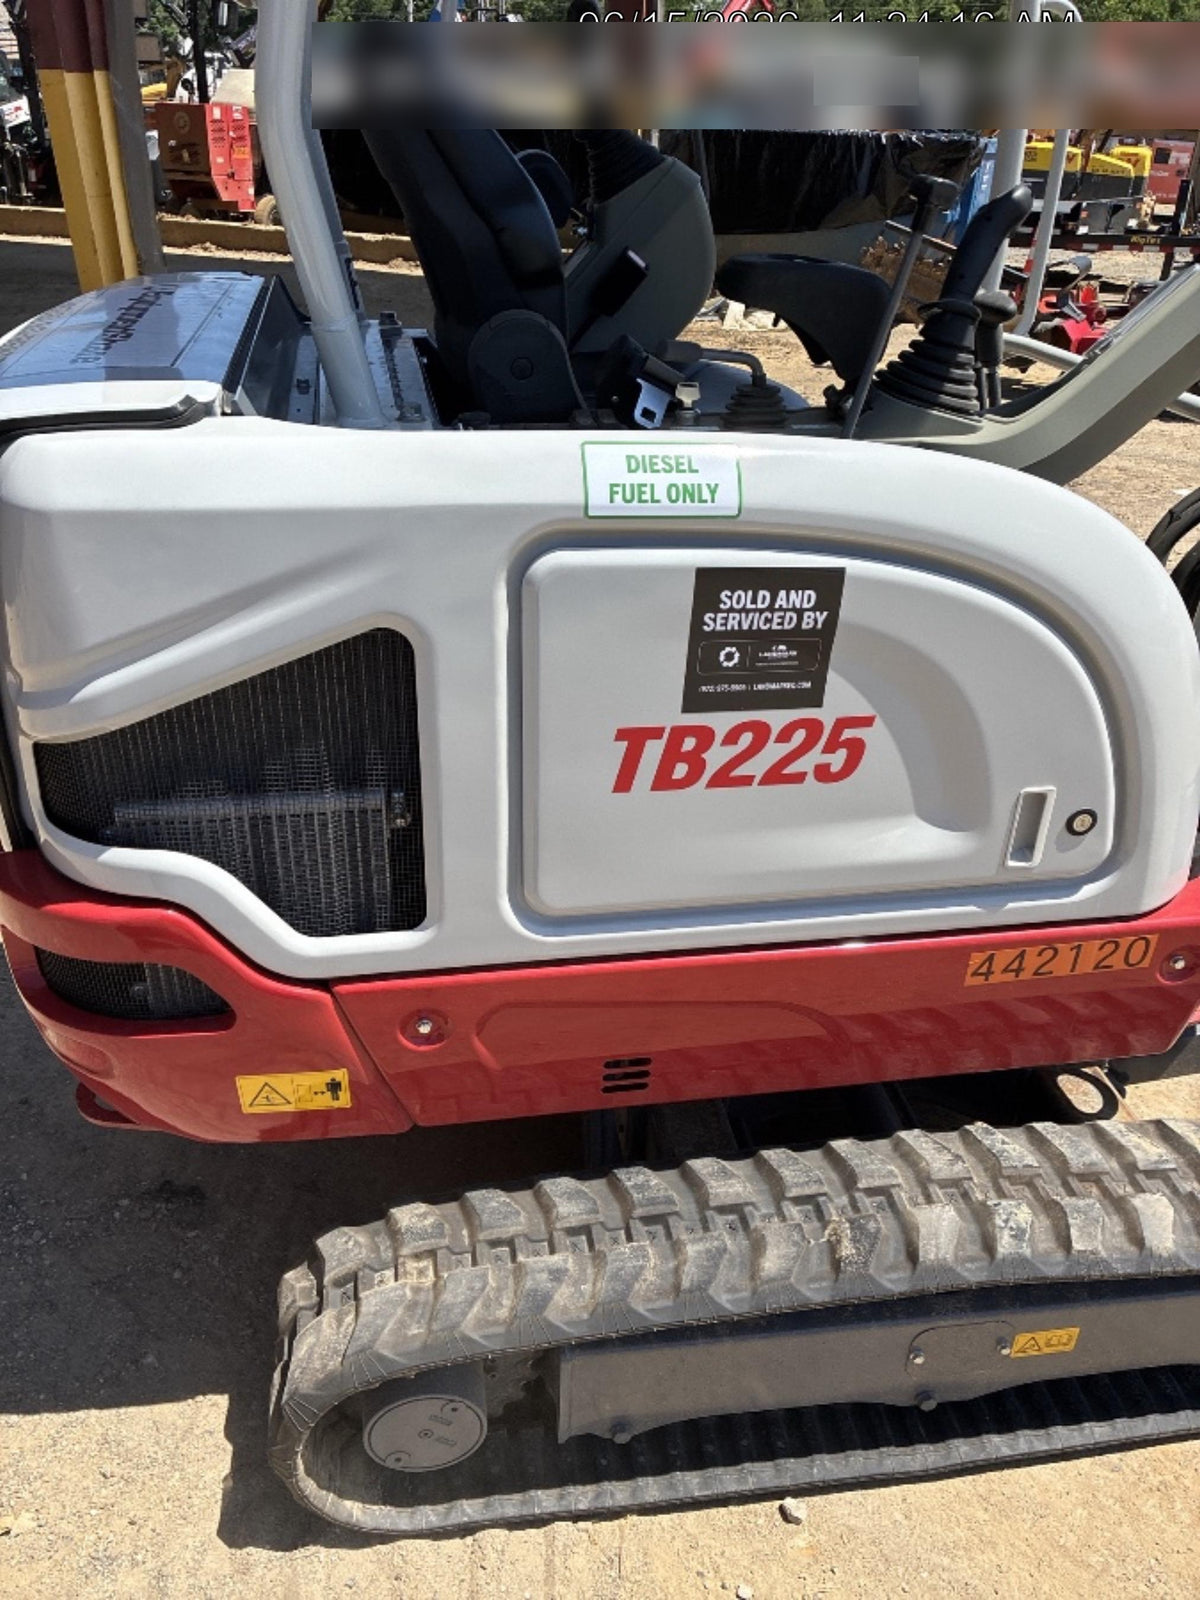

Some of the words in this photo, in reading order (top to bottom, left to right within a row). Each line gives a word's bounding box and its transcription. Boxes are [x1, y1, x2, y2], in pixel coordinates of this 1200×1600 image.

[626, 454, 699, 474] DIESEL
[609, 483, 661, 504] FUEL
[667, 483, 719, 504] ONLY
[719, 590, 771, 610] SOLD
[774, 590, 817, 609] AND
[702, 612, 798, 632] SERVICED
[801, 611, 829, 630] BY
[611, 715, 877, 793] TB225
[970, 936, 1150, 982] 442120
